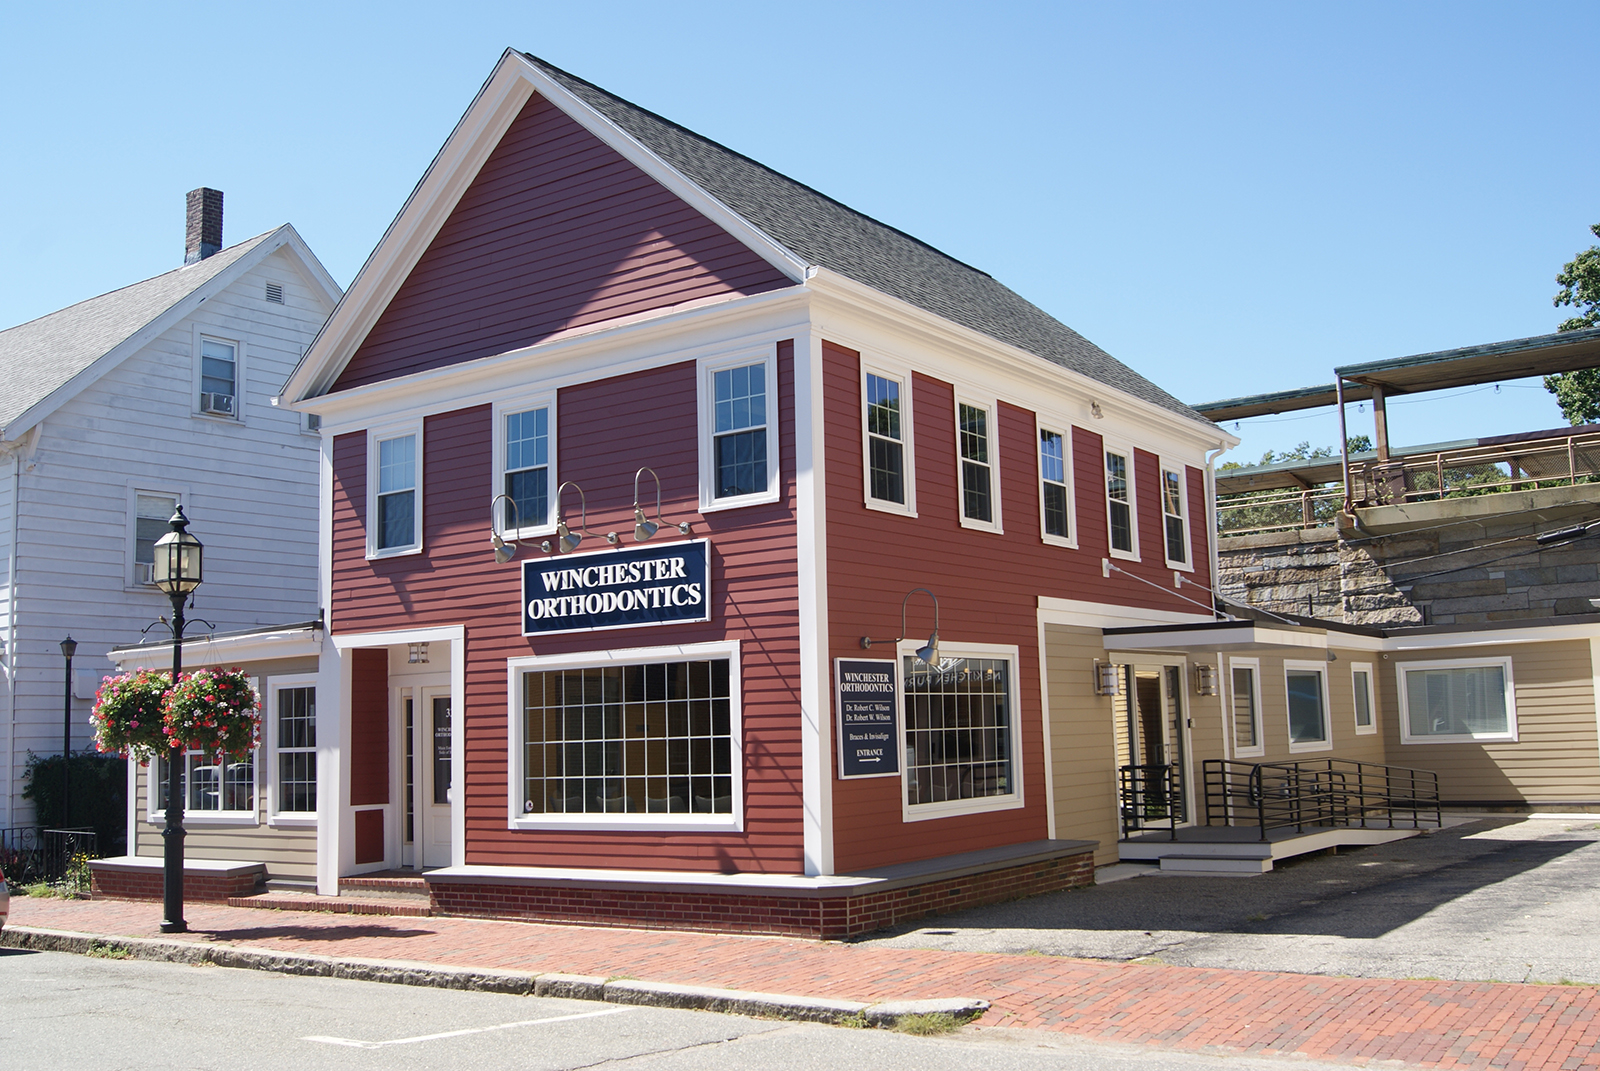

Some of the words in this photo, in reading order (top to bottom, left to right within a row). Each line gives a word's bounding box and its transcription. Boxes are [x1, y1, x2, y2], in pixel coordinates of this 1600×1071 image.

[540, 557, 687, 592] WINCHESTER
[527, 583, 702, 619] ORTHODONTICS
[844, 672, 890, 682] WINCHESTER
[840, 682, 894, 692] ORTHODONTICS
[856, 749, 883, 757] ENTRANCE
